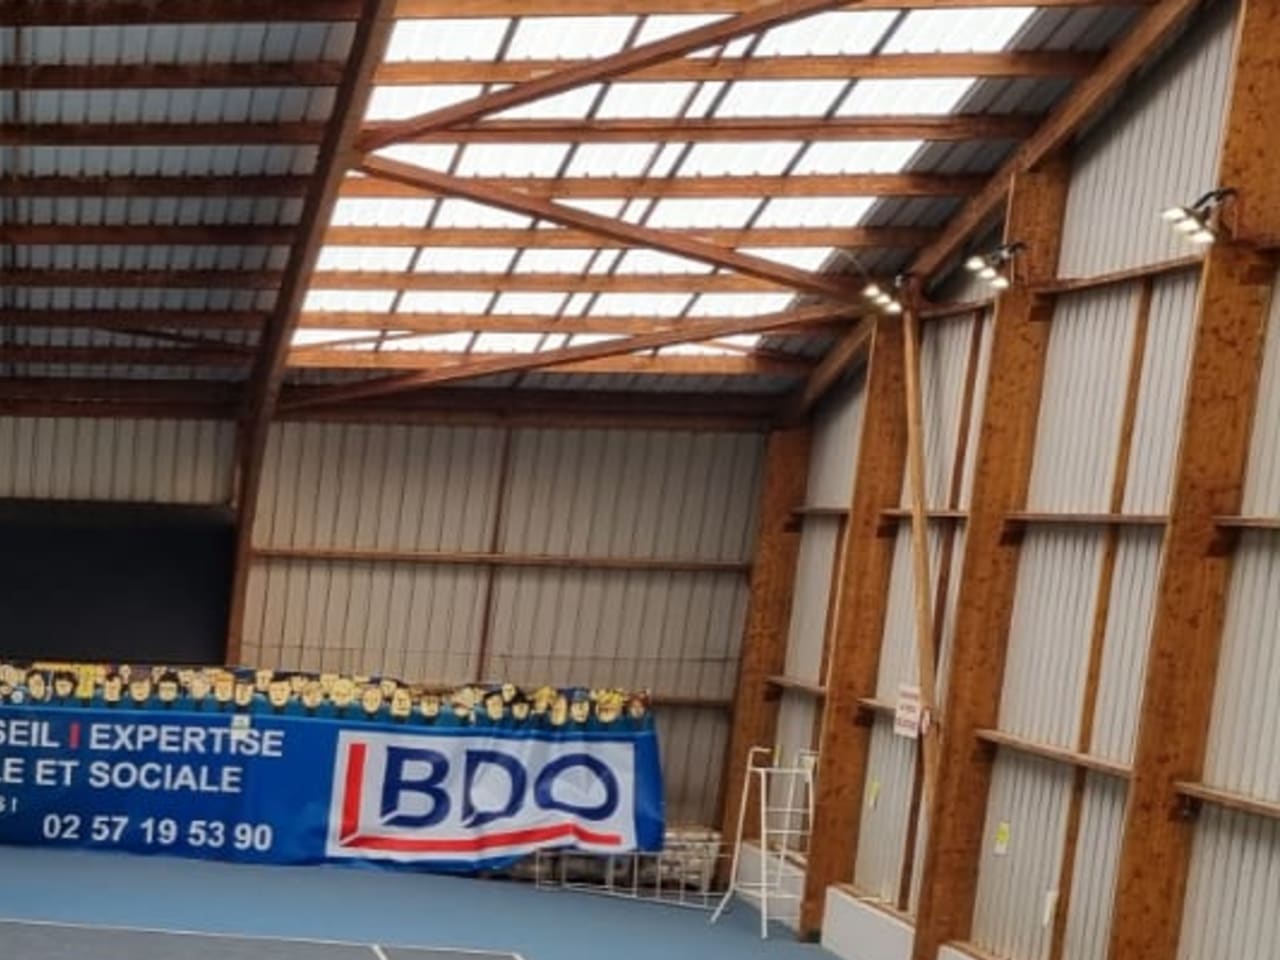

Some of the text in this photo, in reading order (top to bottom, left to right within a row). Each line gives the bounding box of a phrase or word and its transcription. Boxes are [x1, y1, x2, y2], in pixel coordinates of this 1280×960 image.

[90, 723, 285, 757] EXPERTISE
[36, 759, 79, 786] ET
[89, 761, 243, 793] SOCIALE
[380, 746, 619, 829] BDO
[43, 814, 272, 850] 02 57 19 53 90
